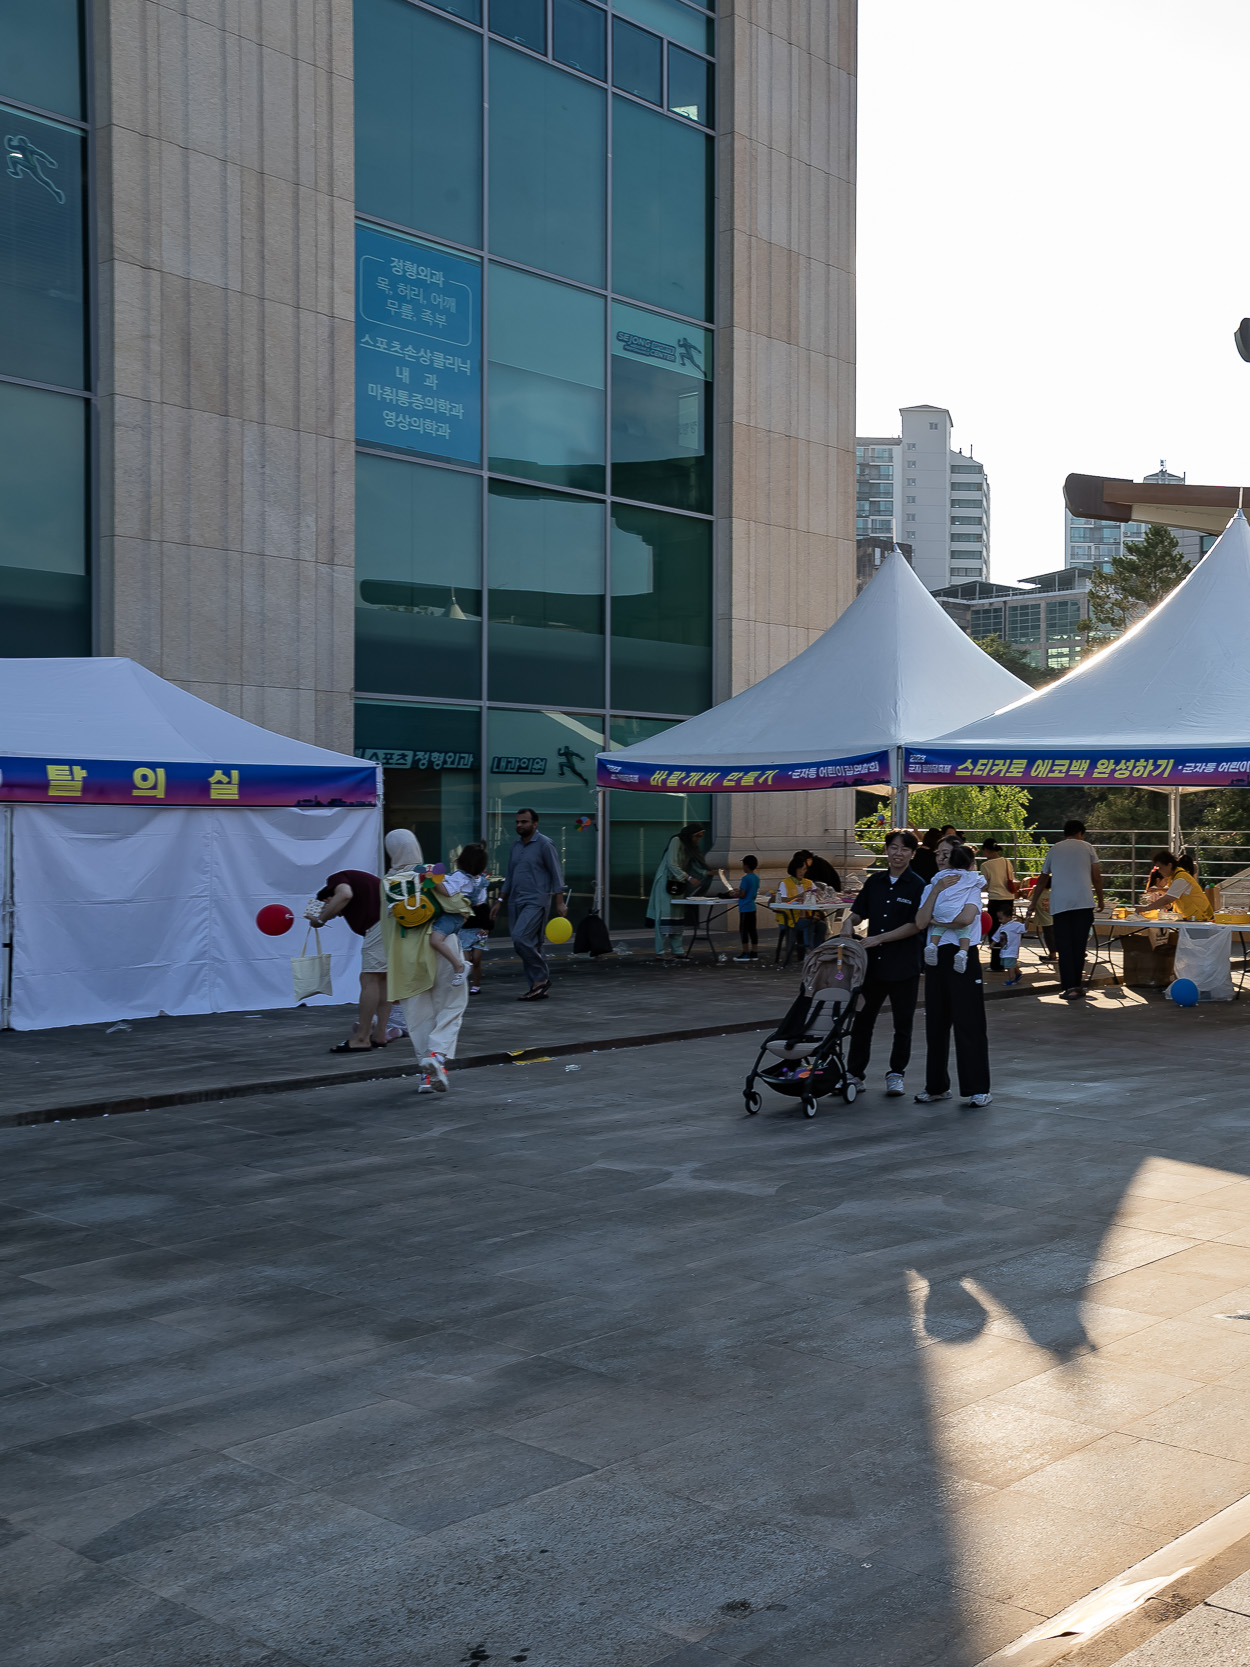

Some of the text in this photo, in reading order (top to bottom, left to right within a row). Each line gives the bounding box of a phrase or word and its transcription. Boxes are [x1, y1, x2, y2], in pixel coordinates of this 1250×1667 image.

[390, 257, 445, 288] 정형외과
[376, 276, 457, 313] 목, 허리, 어깨
[385, 299, 448, 329] 무릎, 족부
[616, 331, 651, 348] SEJONG
[360, 334, 471, 375] 스포츠손상클리닉
[649, 349, 676, 362] CENTER
[367, 383, 465, 419] 마취통증의학과
[382, 410, 451, 439] 영상의학과
[414, 750, 474, 770] 정형외과
[491, 756, 547, 774] 내과의원
[955, 758, 1029, 777] 스티커로
[1030, 759, 1091, 778] 에코백
[1091, 758, 1175, 779] 완성하기
[649, 769, 720, 787] 바람개비
[722, 769, 779, 786] 만들기
[818, 761, 880, 778] 어린이집연합회
